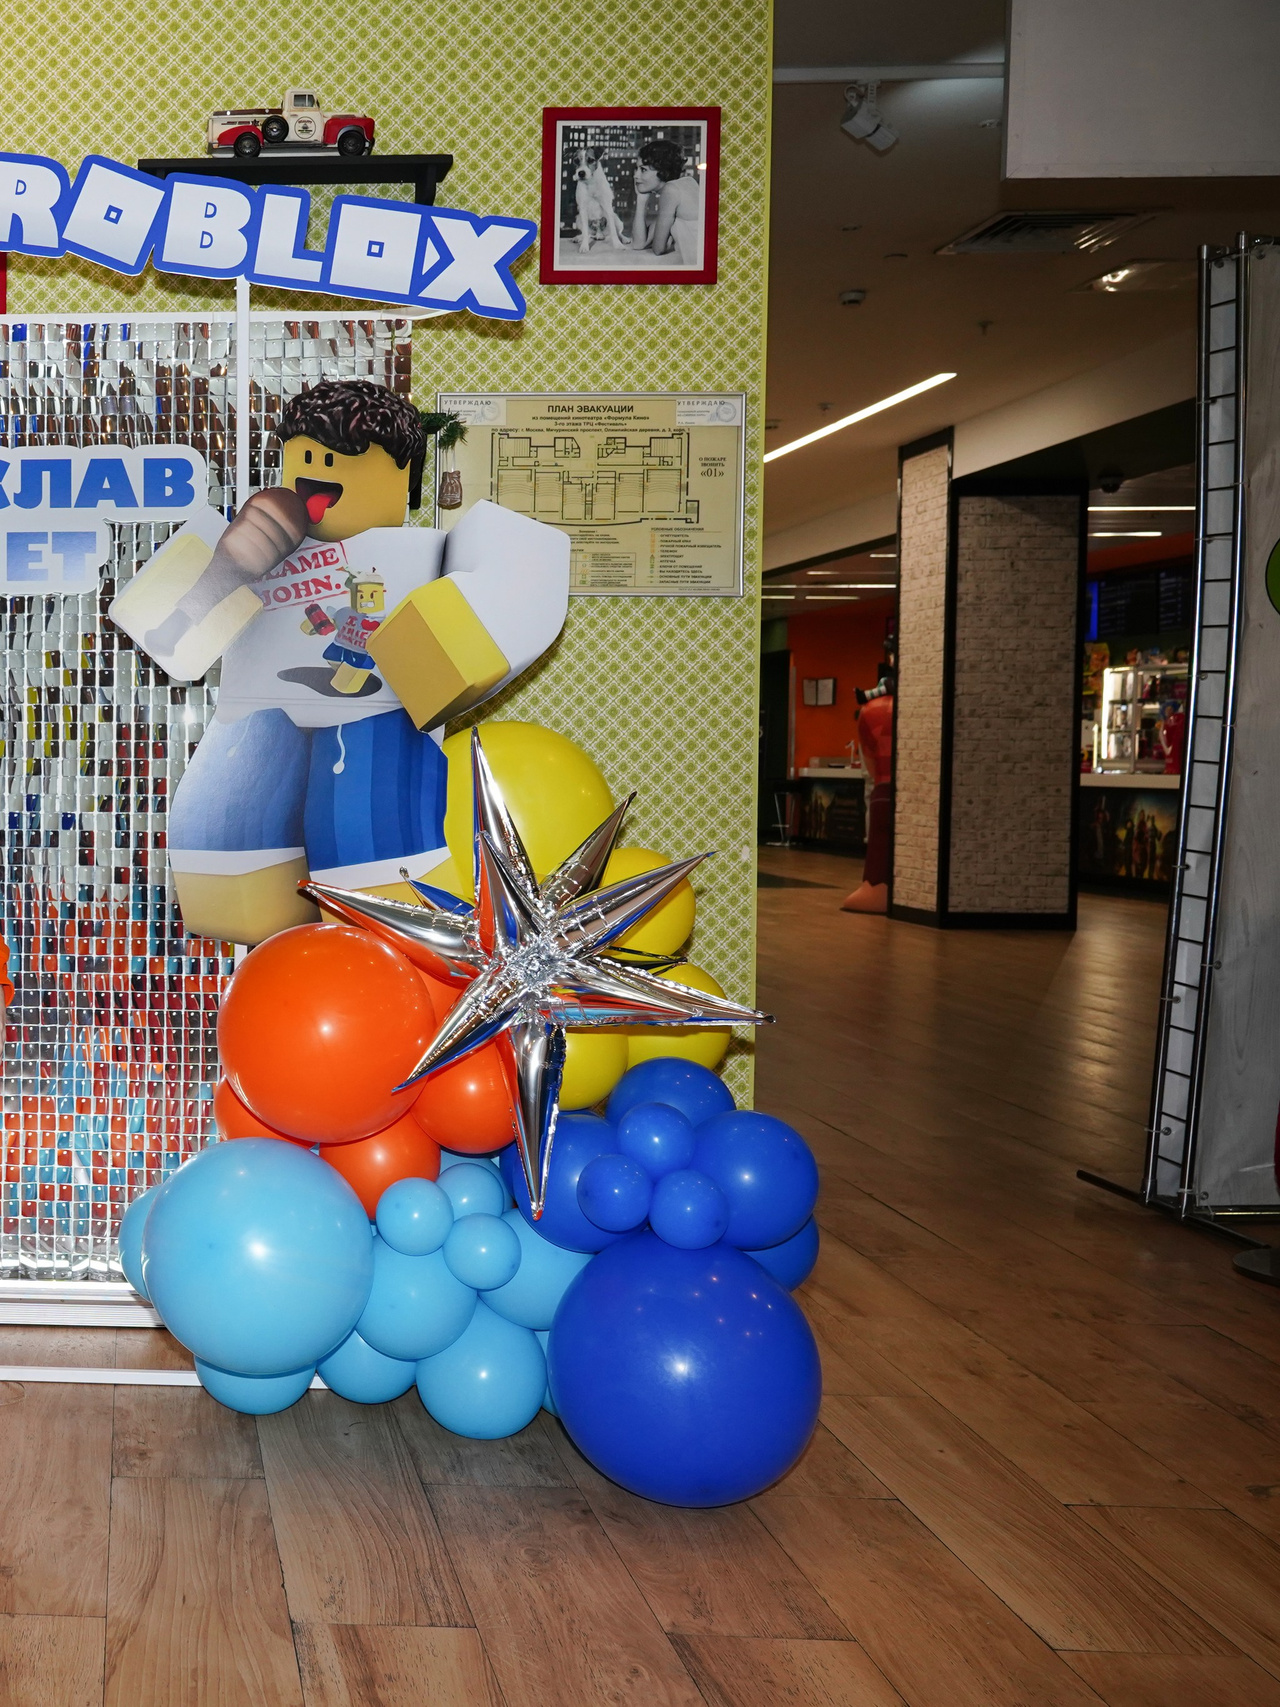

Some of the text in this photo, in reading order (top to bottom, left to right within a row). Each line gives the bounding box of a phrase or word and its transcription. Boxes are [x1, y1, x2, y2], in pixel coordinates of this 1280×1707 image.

[547, 405, 634, 414] ПЛАН ЭВАКУАЦИИ
[255, 548, 339, 582] LAME
[261, 574, 342, 607] JOHN.
